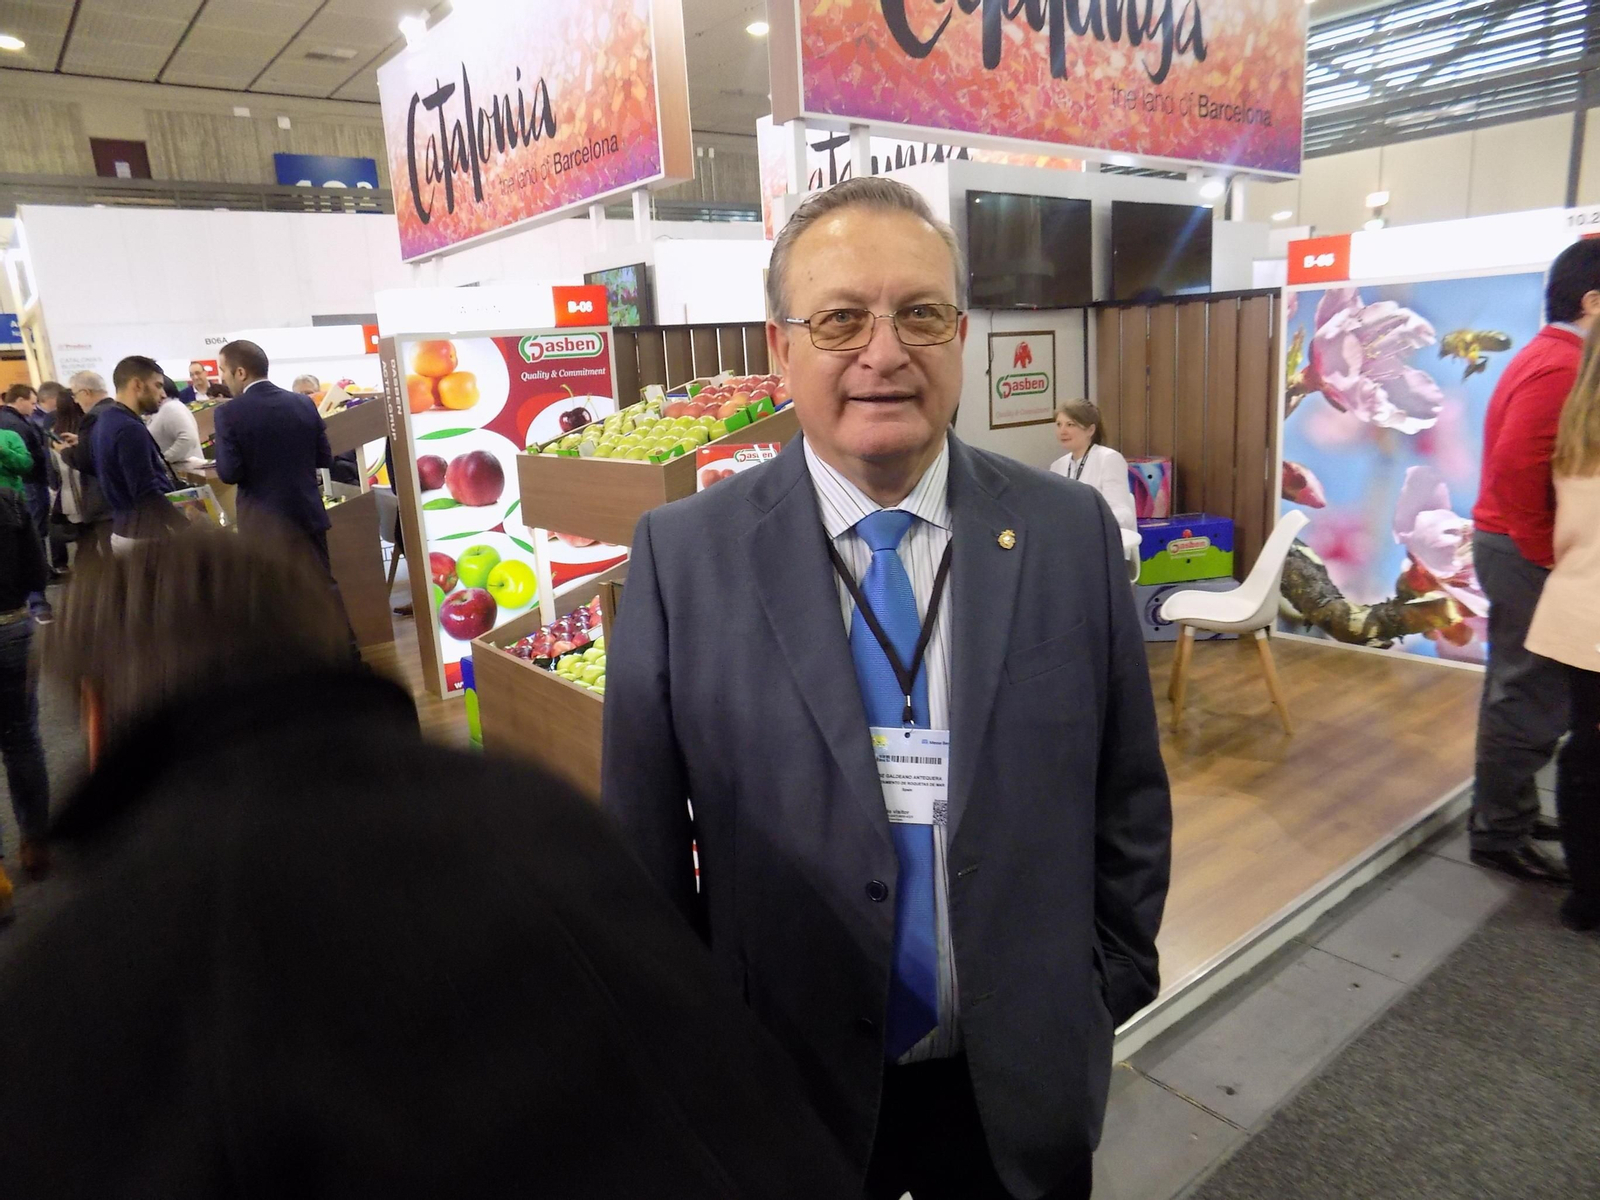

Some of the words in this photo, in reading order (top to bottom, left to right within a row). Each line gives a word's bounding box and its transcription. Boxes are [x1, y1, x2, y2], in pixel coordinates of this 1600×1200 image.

[1111, 83, 1137, 110] the
[1142, 87, 1174, 116] land
[1198, 94, 1272, 127] Barcelona
[407, 61, 556, 225] Catalonia
[553, 134, 619, 175] Barcelona
[521, 370, 550, 382] Quality
[551, 369, 558, 378] &
[559, 367, 606, 378] Commitment
